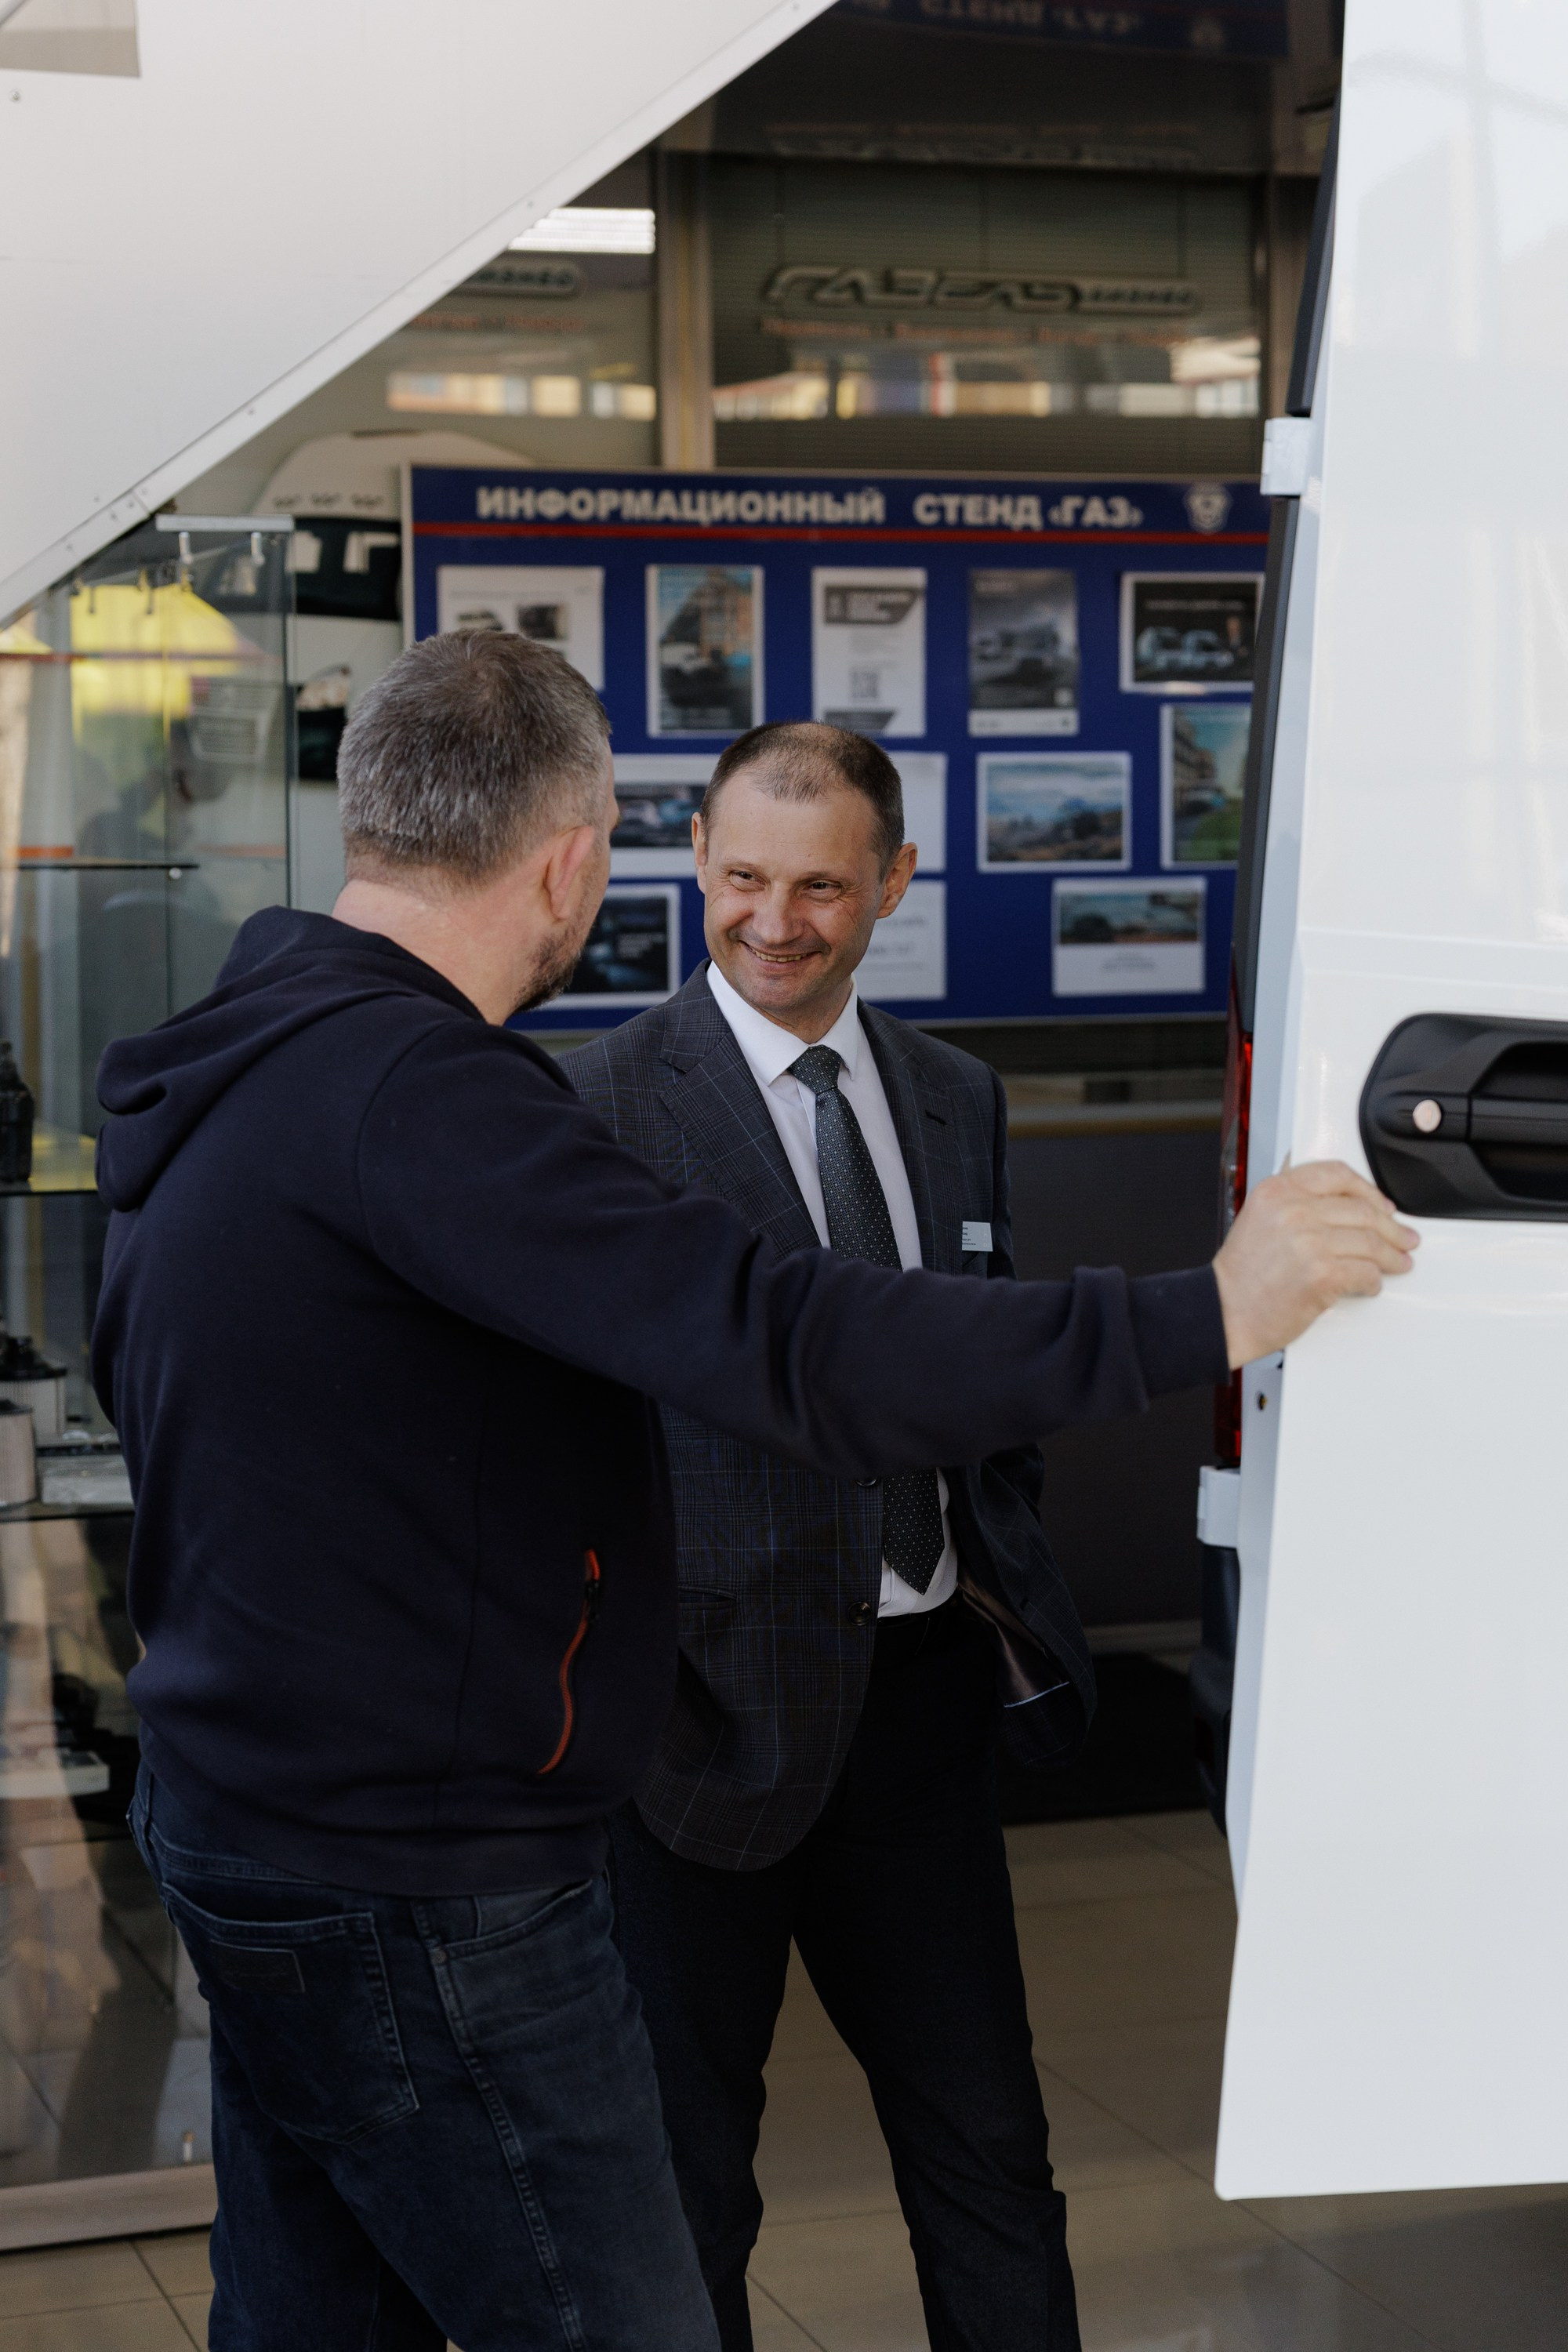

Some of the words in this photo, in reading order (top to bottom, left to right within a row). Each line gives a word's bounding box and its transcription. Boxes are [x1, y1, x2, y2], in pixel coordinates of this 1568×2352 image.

[477, 486, 886, 527] ИНФОРМАЦИОННЫЙ
[913, 493, 1044, 531] СТЕНД
[1047, 495, 1144, 528] «ГАЗ»
